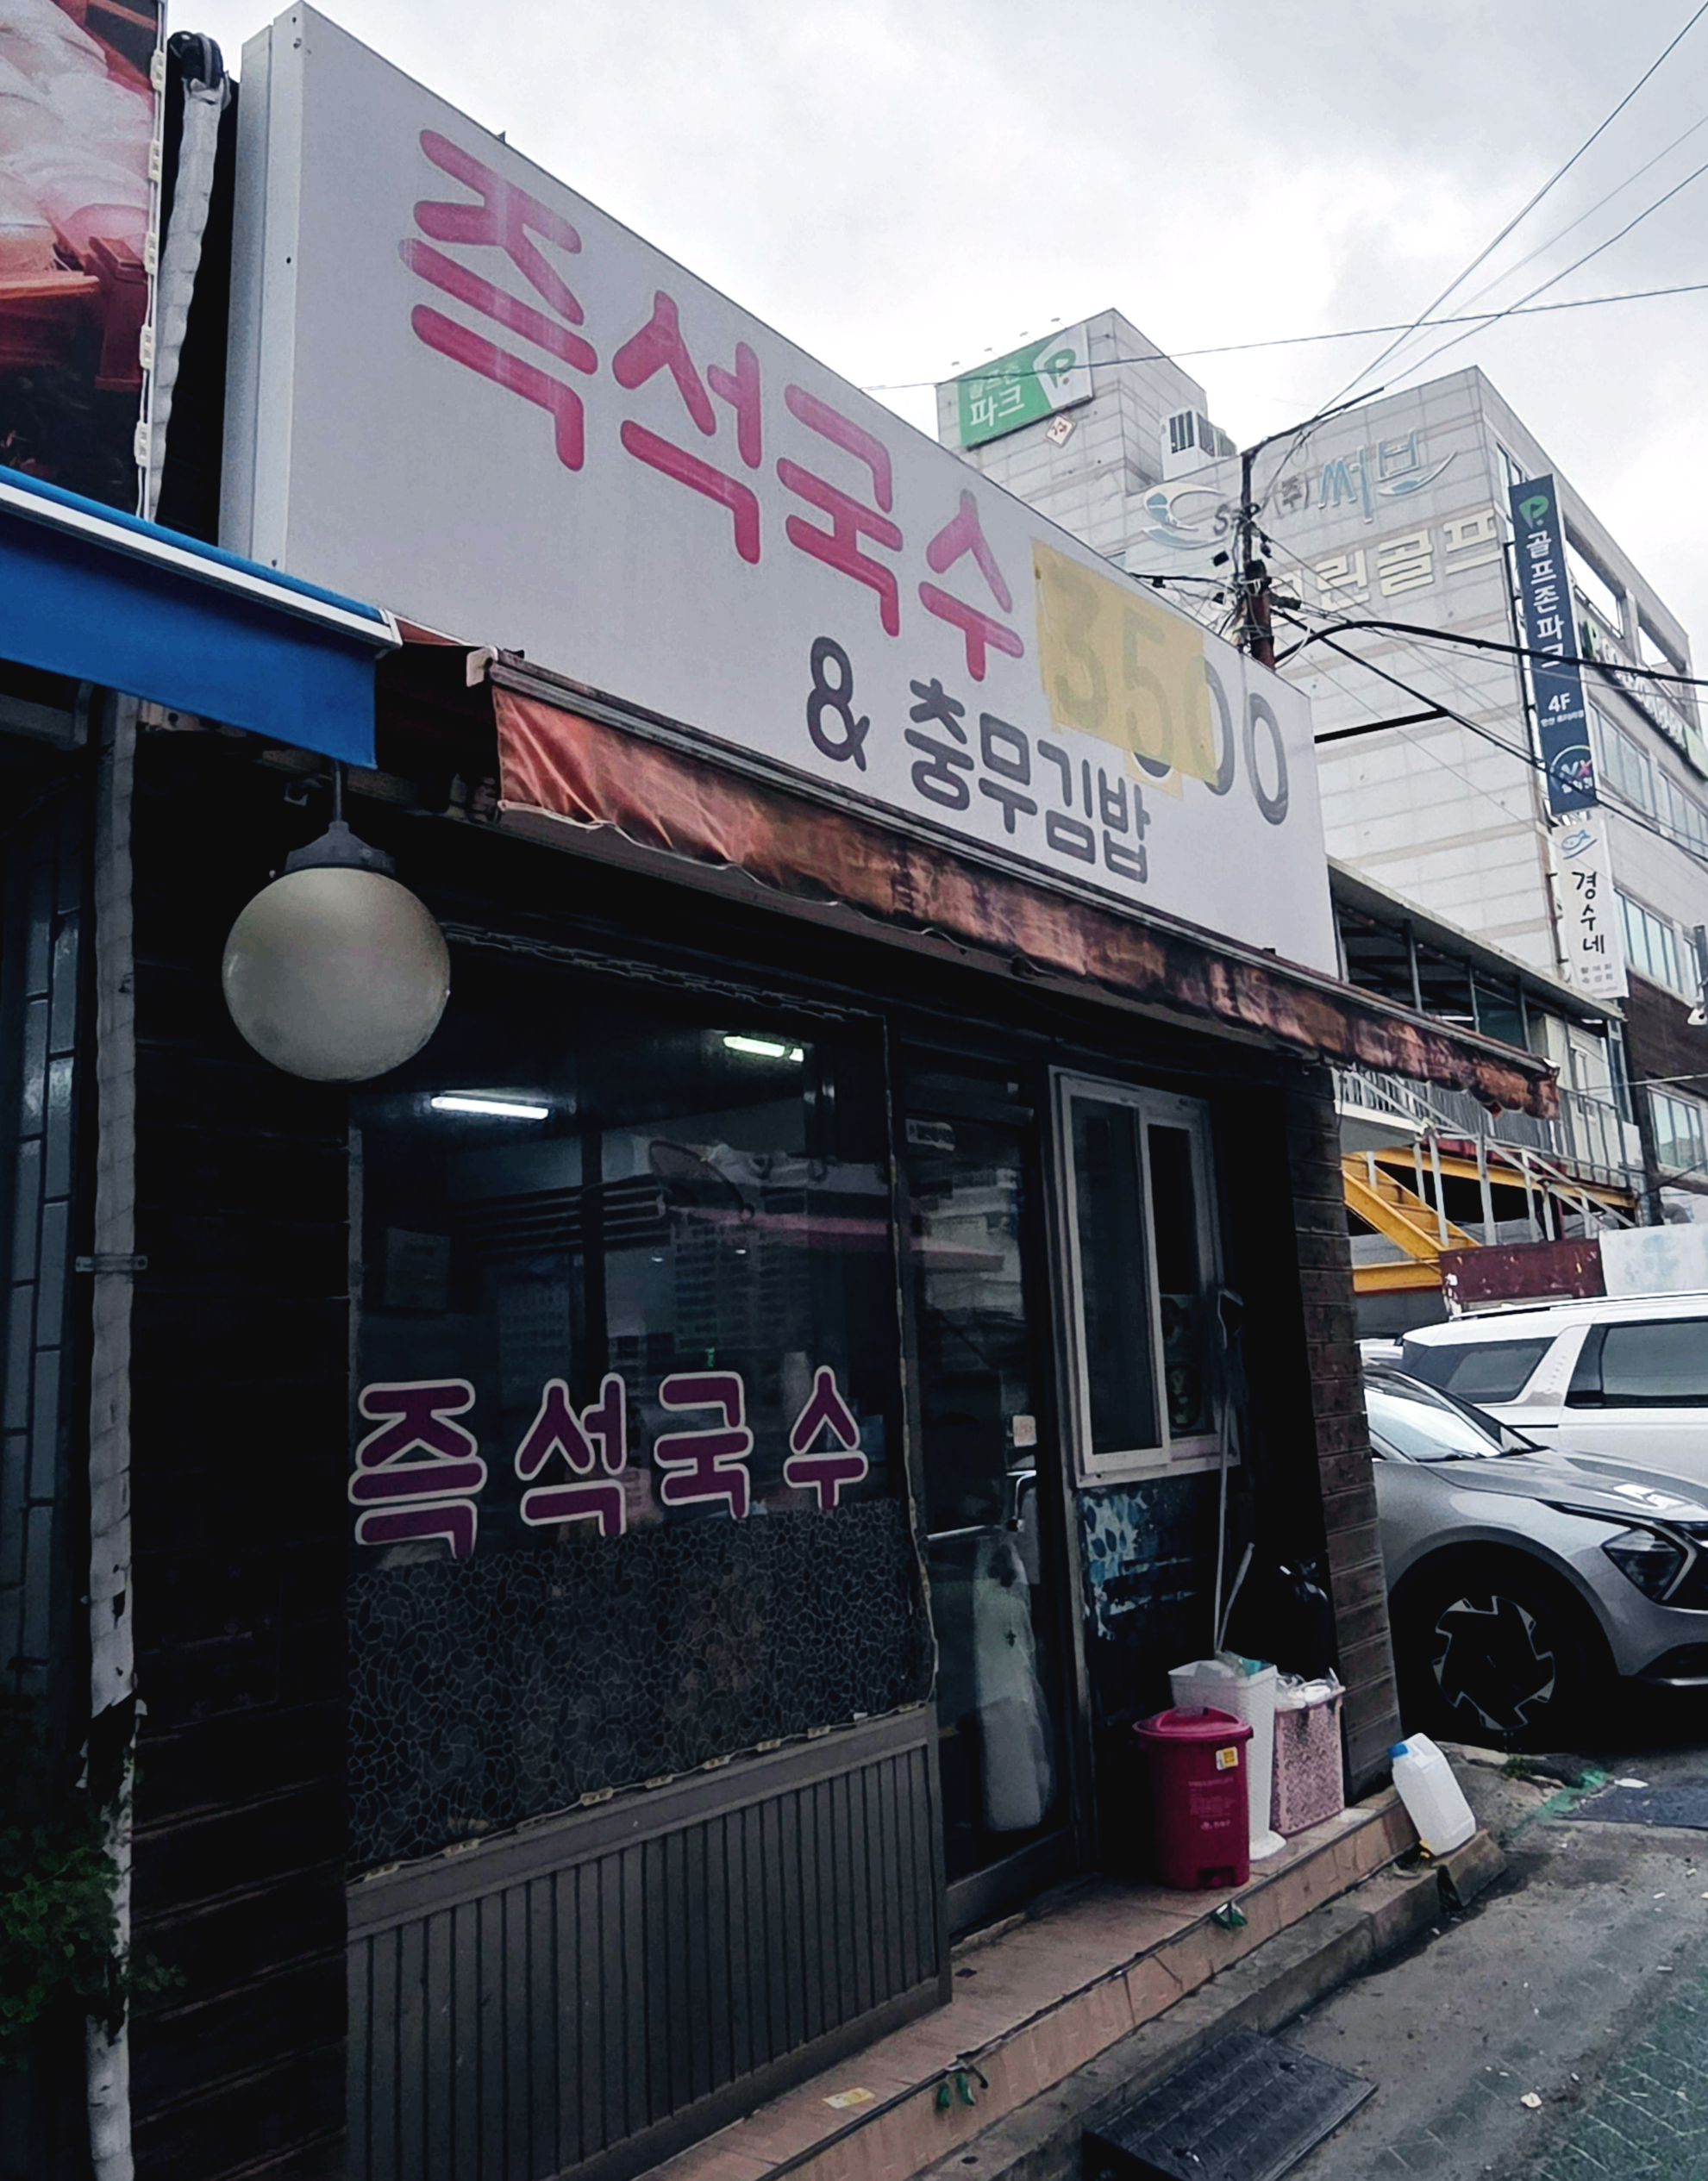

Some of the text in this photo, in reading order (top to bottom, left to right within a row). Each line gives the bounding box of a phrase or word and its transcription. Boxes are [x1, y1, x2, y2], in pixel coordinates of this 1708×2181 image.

[398, 128, 1025, 682] 즉석국수
[970, 384, 1025, 428] 파크
[805, 635, 1152, 885] & 충무김밥
[1548, 692, 1571, 713] 4F
[1571, 871, 1605, 955] 경수네
[347, 1365, 869, 1560] 즉석국수
